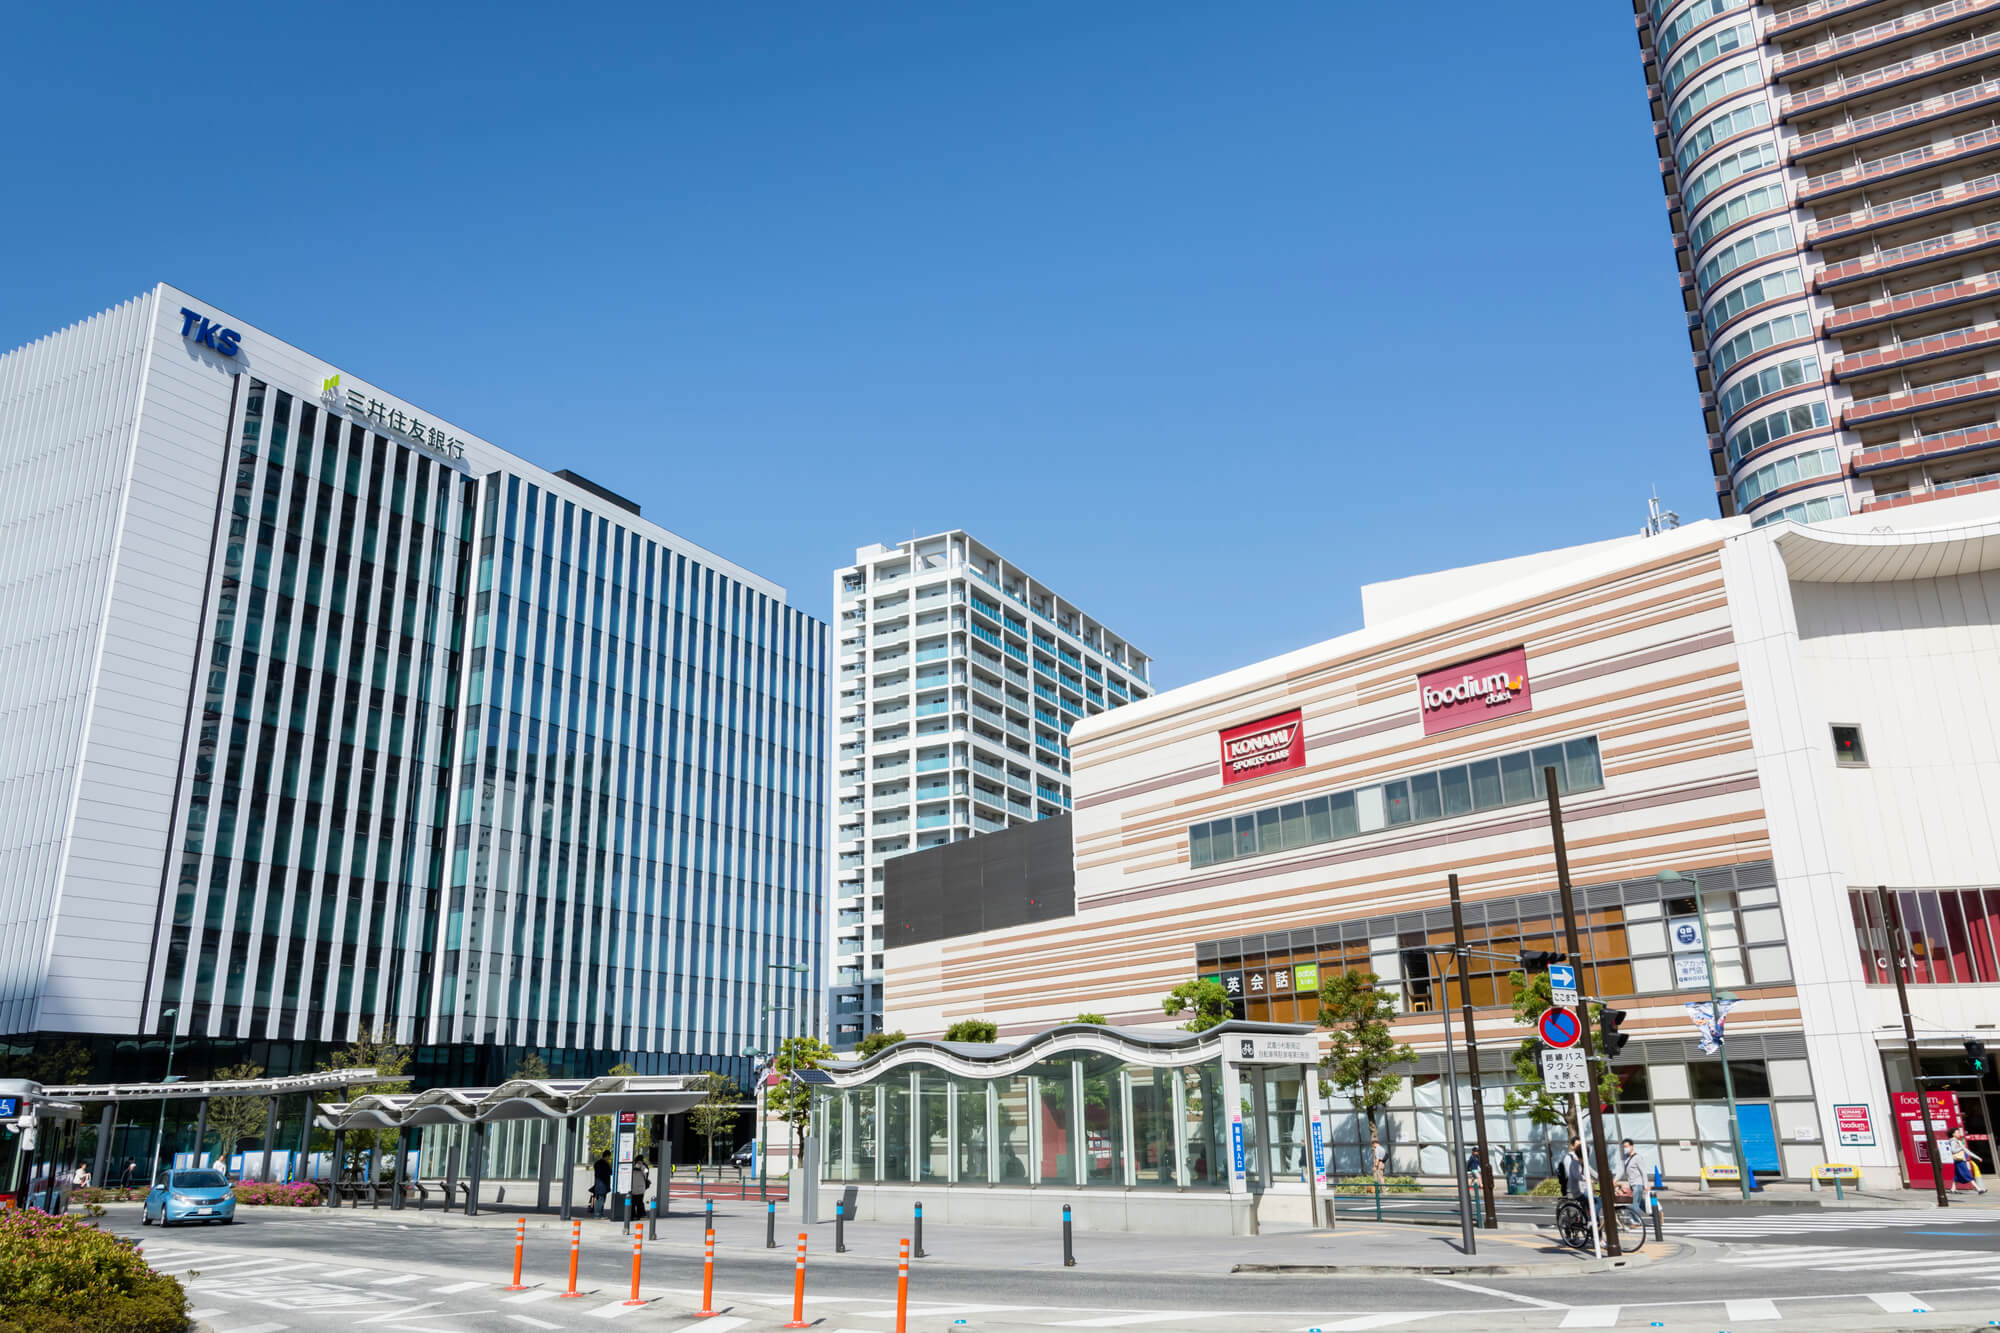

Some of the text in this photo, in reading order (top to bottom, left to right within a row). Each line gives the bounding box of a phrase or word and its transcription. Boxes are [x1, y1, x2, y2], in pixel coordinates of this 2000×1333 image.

[181, 307, 242, 357] TKS
[345, 388, 465, 460] 三井住友銀行
[1423, 673, 1509, 710] foodium
[1231, 729, 1289, 756] KONAMI
[1227, 970, 1289, 993] 英会話
[1554, 992, 1577, 1002] ここまで
[1546, 1052, 1583, 1062] 路線バス
[1547, 1062, 1585, 1071] タクシー
[1550, 1080, 1585, 1089] ここまで
